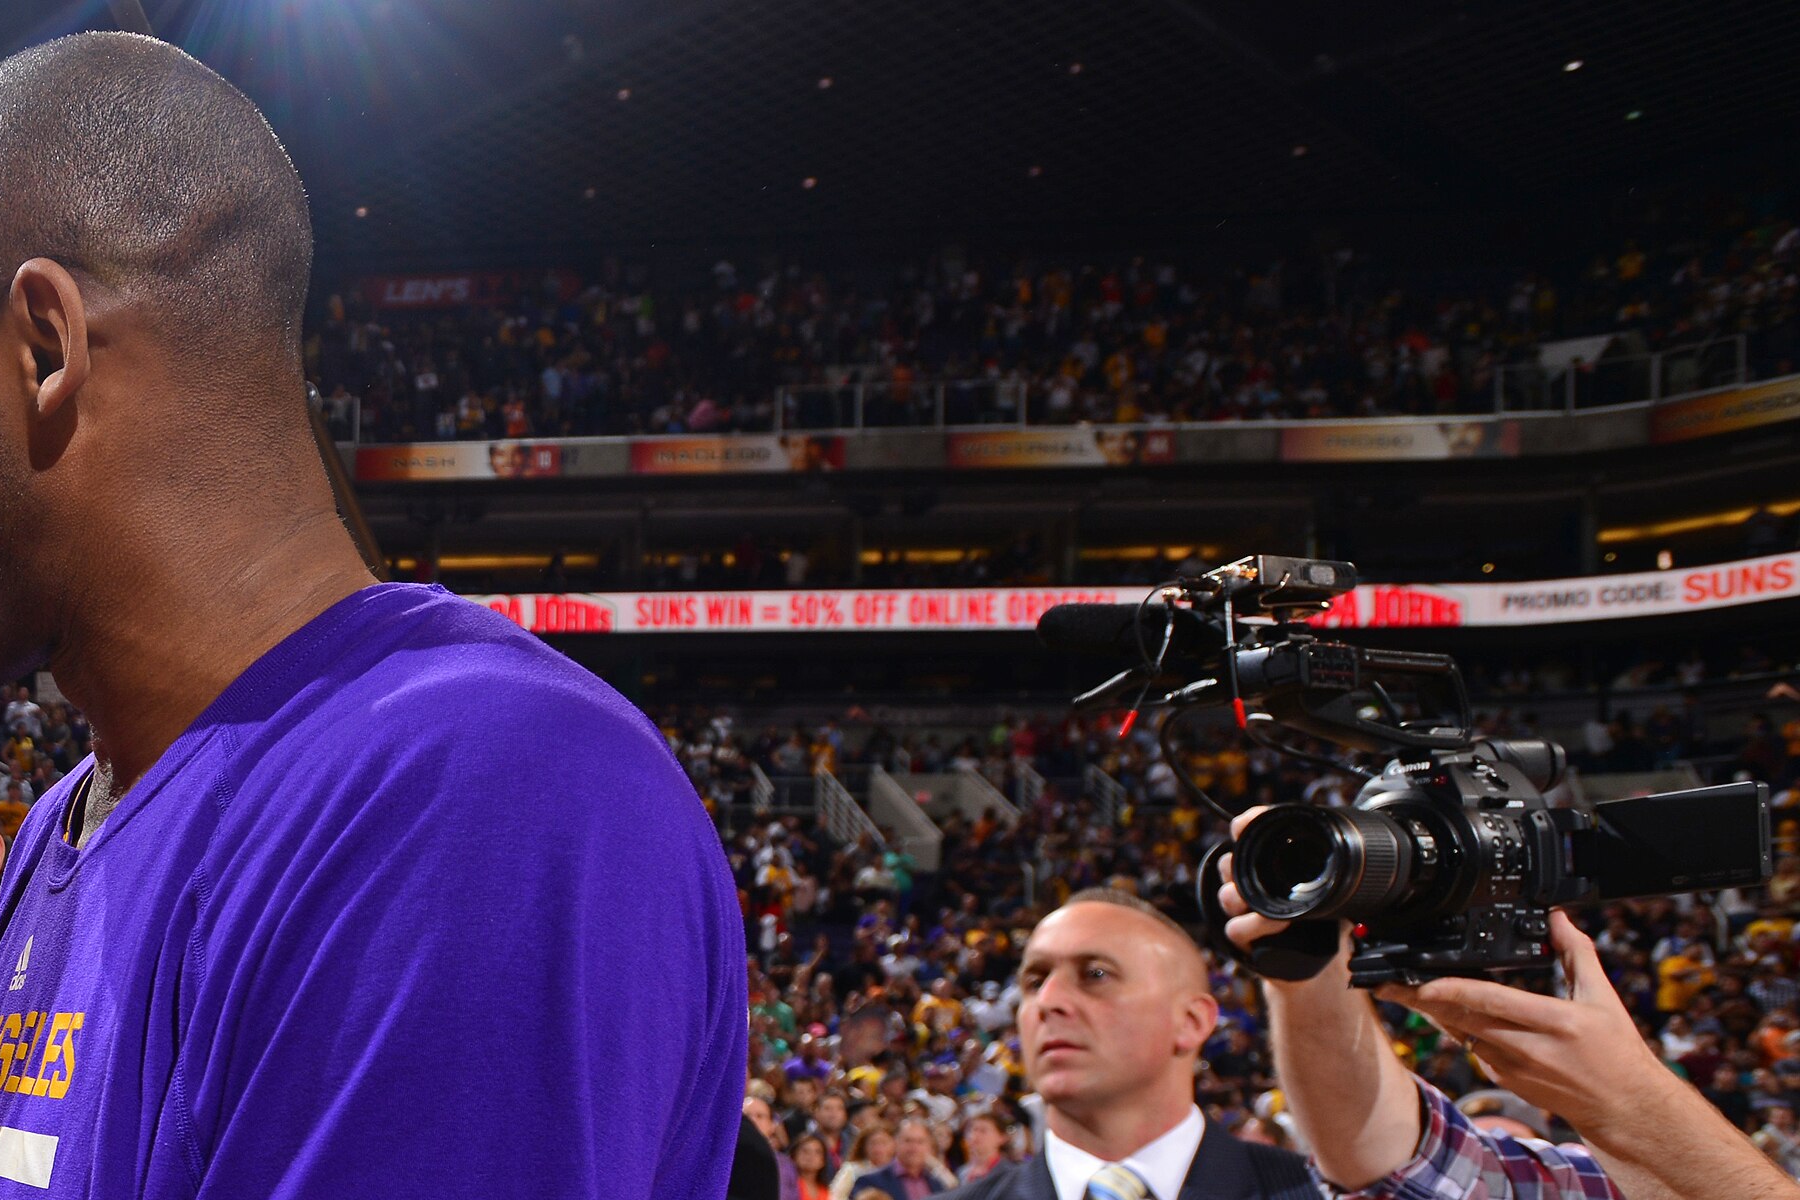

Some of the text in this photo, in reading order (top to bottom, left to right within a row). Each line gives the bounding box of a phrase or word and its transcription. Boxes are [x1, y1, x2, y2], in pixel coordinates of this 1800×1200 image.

[1501, 559, 1796, 613] PROMO CODE: SUNS
[636, 596, 699, 626] SUNS
[707, 595, 753, 626] WIN
[789, 594, 845, 625] 50%
[853, 593, 899, 624] OFF
[907, 591, 998, 624] ONLINE
[1391, 760, 1430, 775] Canon
